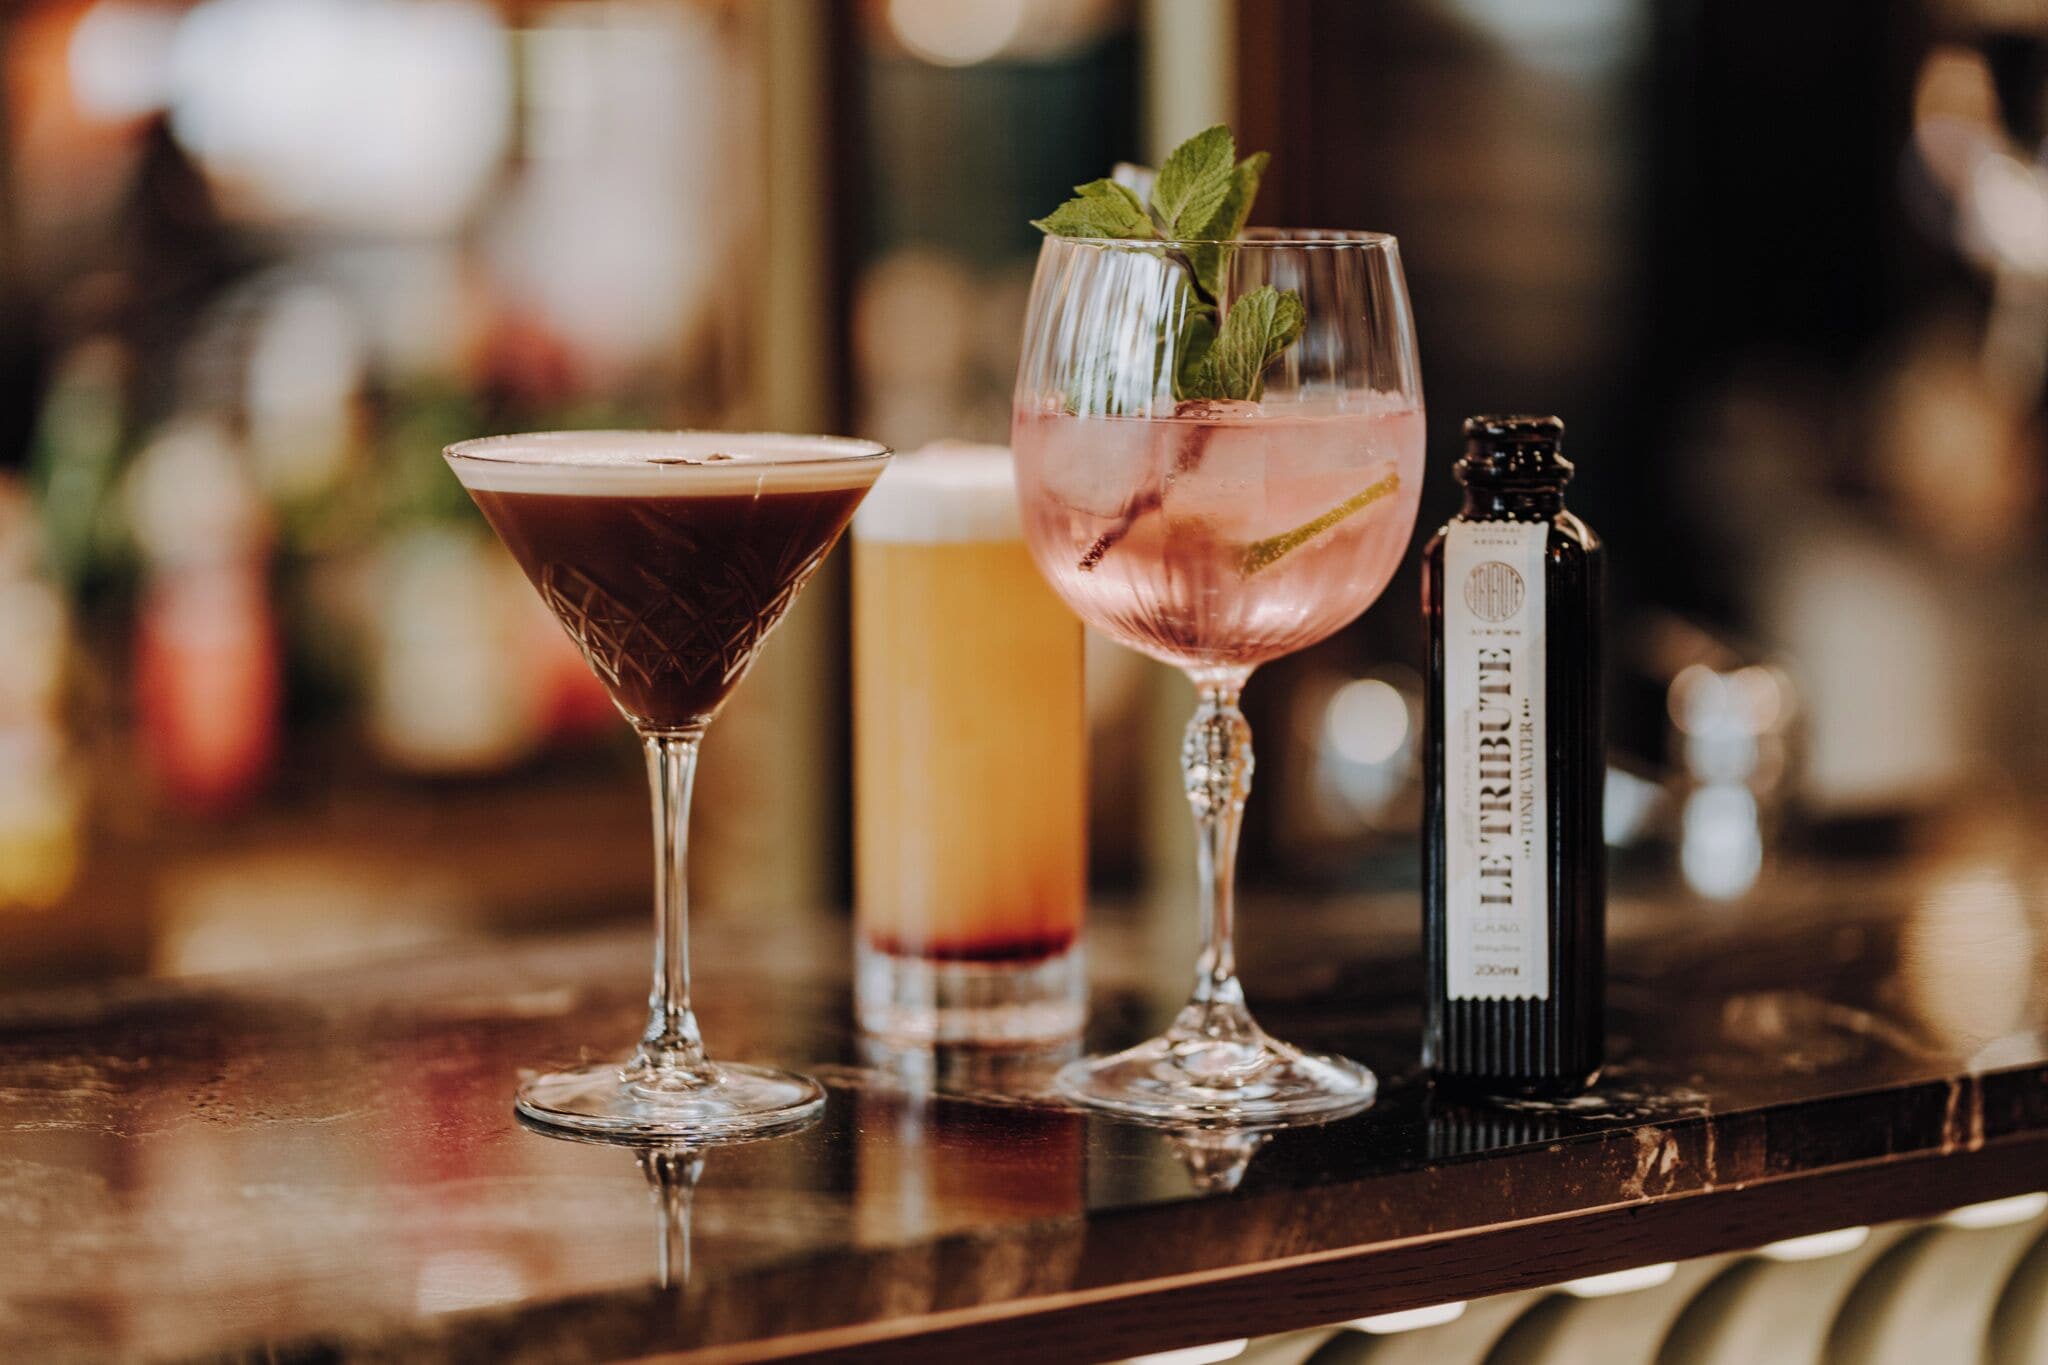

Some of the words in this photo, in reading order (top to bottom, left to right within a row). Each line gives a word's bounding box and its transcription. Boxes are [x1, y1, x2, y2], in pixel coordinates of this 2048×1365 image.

[1474, 538, 1519, 546] AROMAS
[1479, 648, 1512, 843] TRIBUTE
[1520, 721, 1535, 782] WATER
[1520, 784, 1535, 836] TONIC
[1479, 855, 1512, 907] LE
[1474, 963, 1520, 976] 200ml
